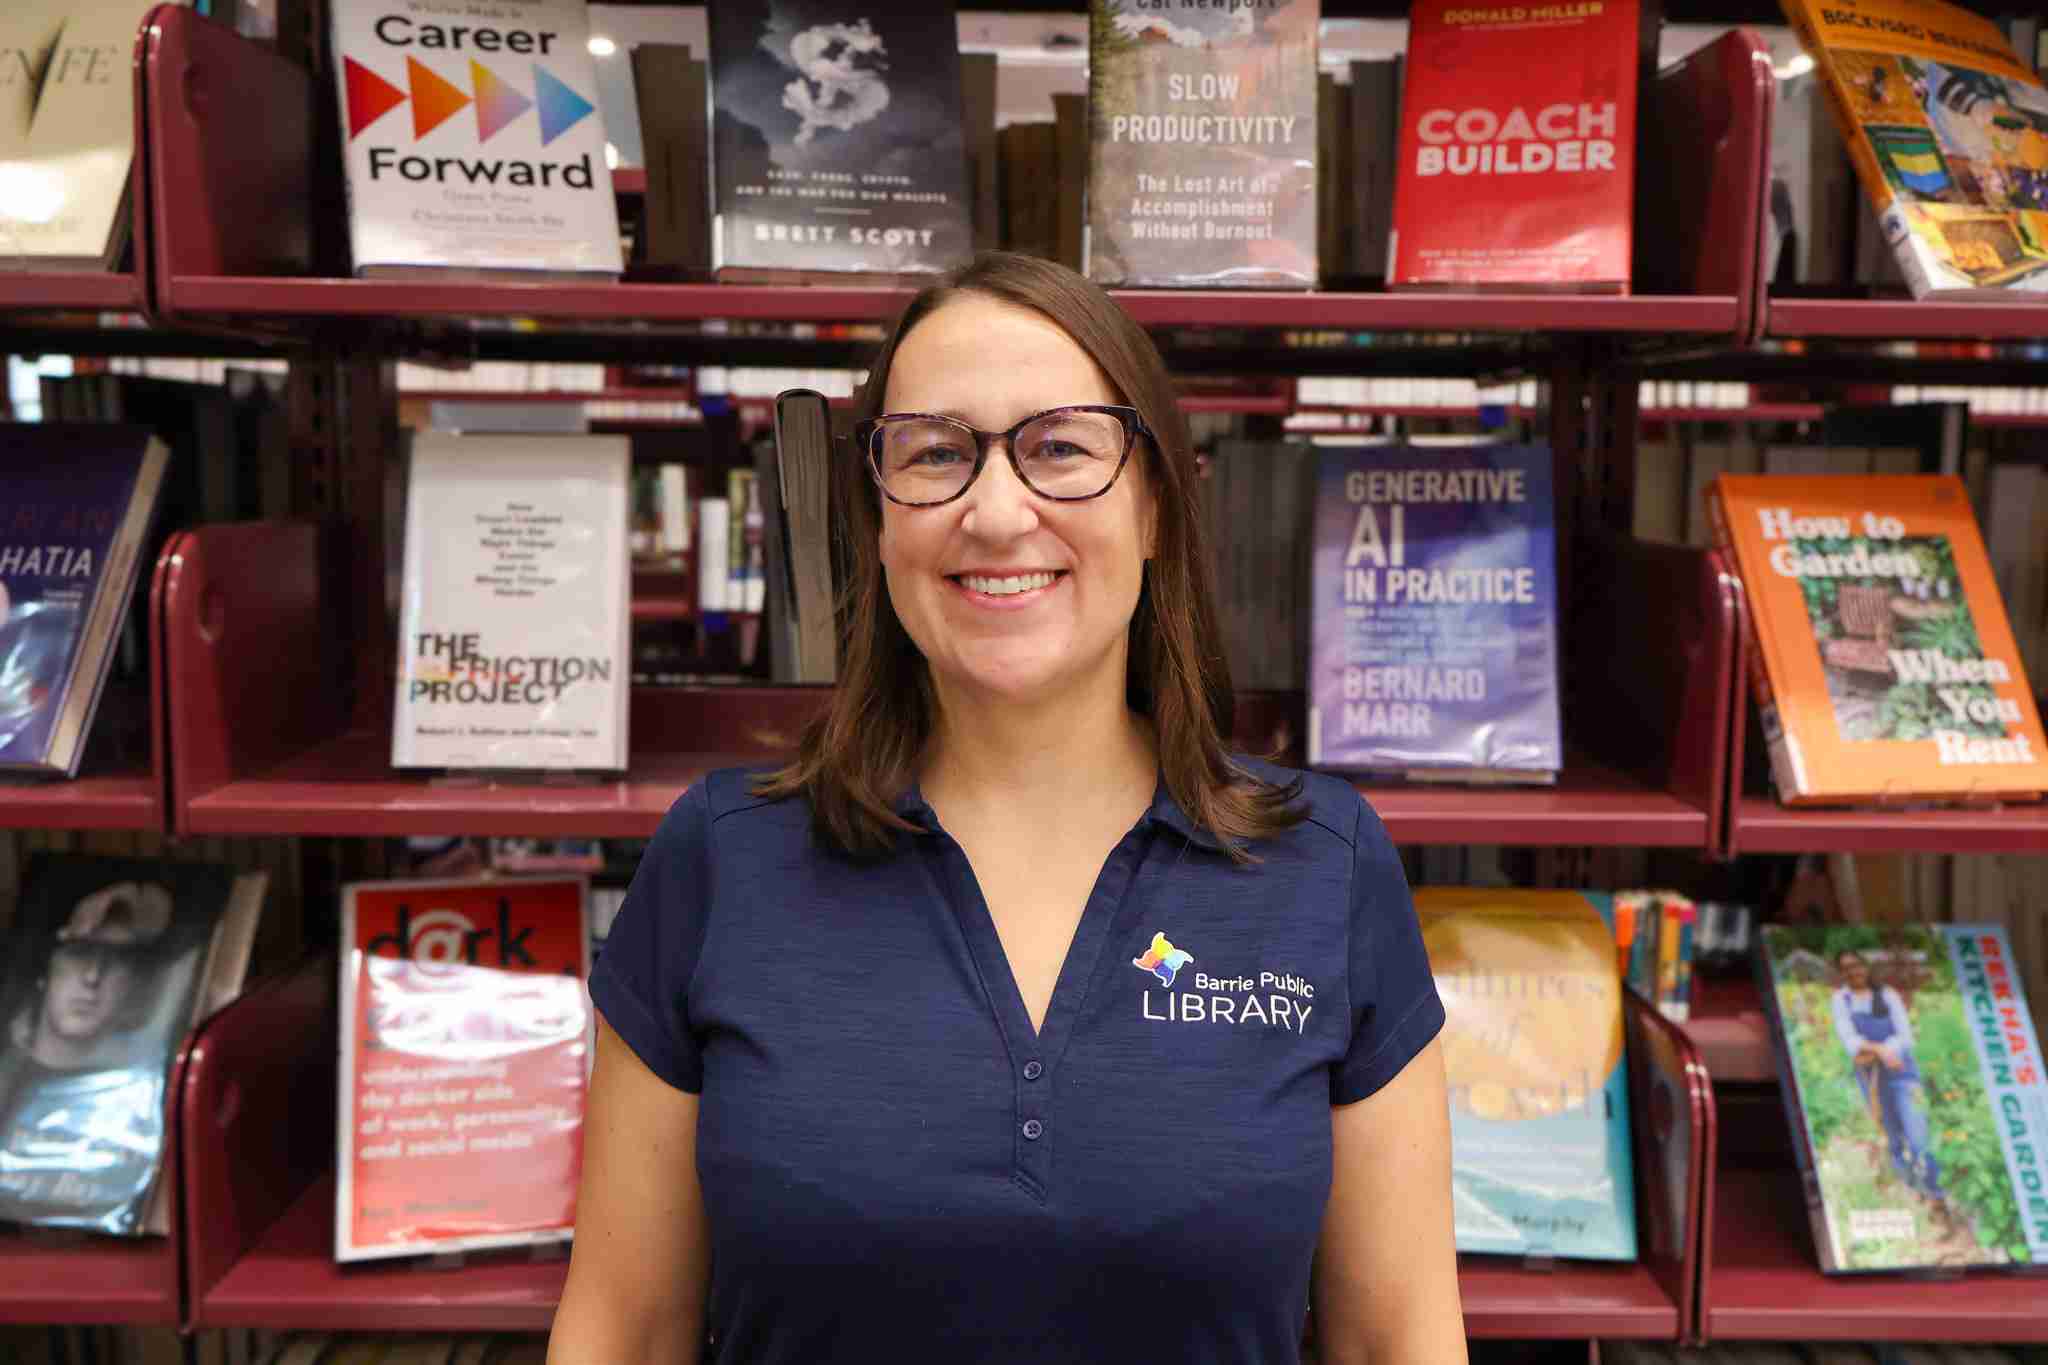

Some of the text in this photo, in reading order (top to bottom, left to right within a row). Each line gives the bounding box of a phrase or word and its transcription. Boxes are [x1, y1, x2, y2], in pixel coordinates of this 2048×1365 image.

[1444, 2, 1604, 24] DONALD MILLER
[375, 15, 557, 54] Career
[1168, 73, 1240, 101] SLOW
[1112, 114, 1296, 144] PRODUCTIVITY
[1416, 103, 1617, 144] COACH
[369, 148, 594, 190] Forward
[1416, 140, 1616, 176] BUILDER
[1137, 173, 1266, 193] The Lost Art of
[1131, 197, 1274, 219] Accomplishment
[754, 223, 934, 247] BRETT SCOTT
[1132, 221, 1274, 240] Without Burnout
[1345, 469, 1527, 503] GENERATIVE
[1345, 504, 1405, 567] AI
[1758, 506, 1906, 540] How to
[0, 545, 92, 576] HATIA
[1770, 544, 1922, 578] Garden
[1344, 568, 1536, 603] IN PRACTICE
[413, 632, 480, 658] THE
[450, 655, 612, 687] FRICTION
[1888, 648, 2011, 683] When
[409, 678, 564, 704] PROJECT
[1343, 666, 1487, 701] BERNARD
[1342, 702, 1433, 737] MARR
[1937, 687, 2023, 725] You
[1934, 728, 2036, 765] Rent
[1195, 971, 1314, 998] Barrie Public
[1143, 990, 1312, 1035] LIBRARY
[1955, 934, 2048, 1244] KITCHEN GARDEN
